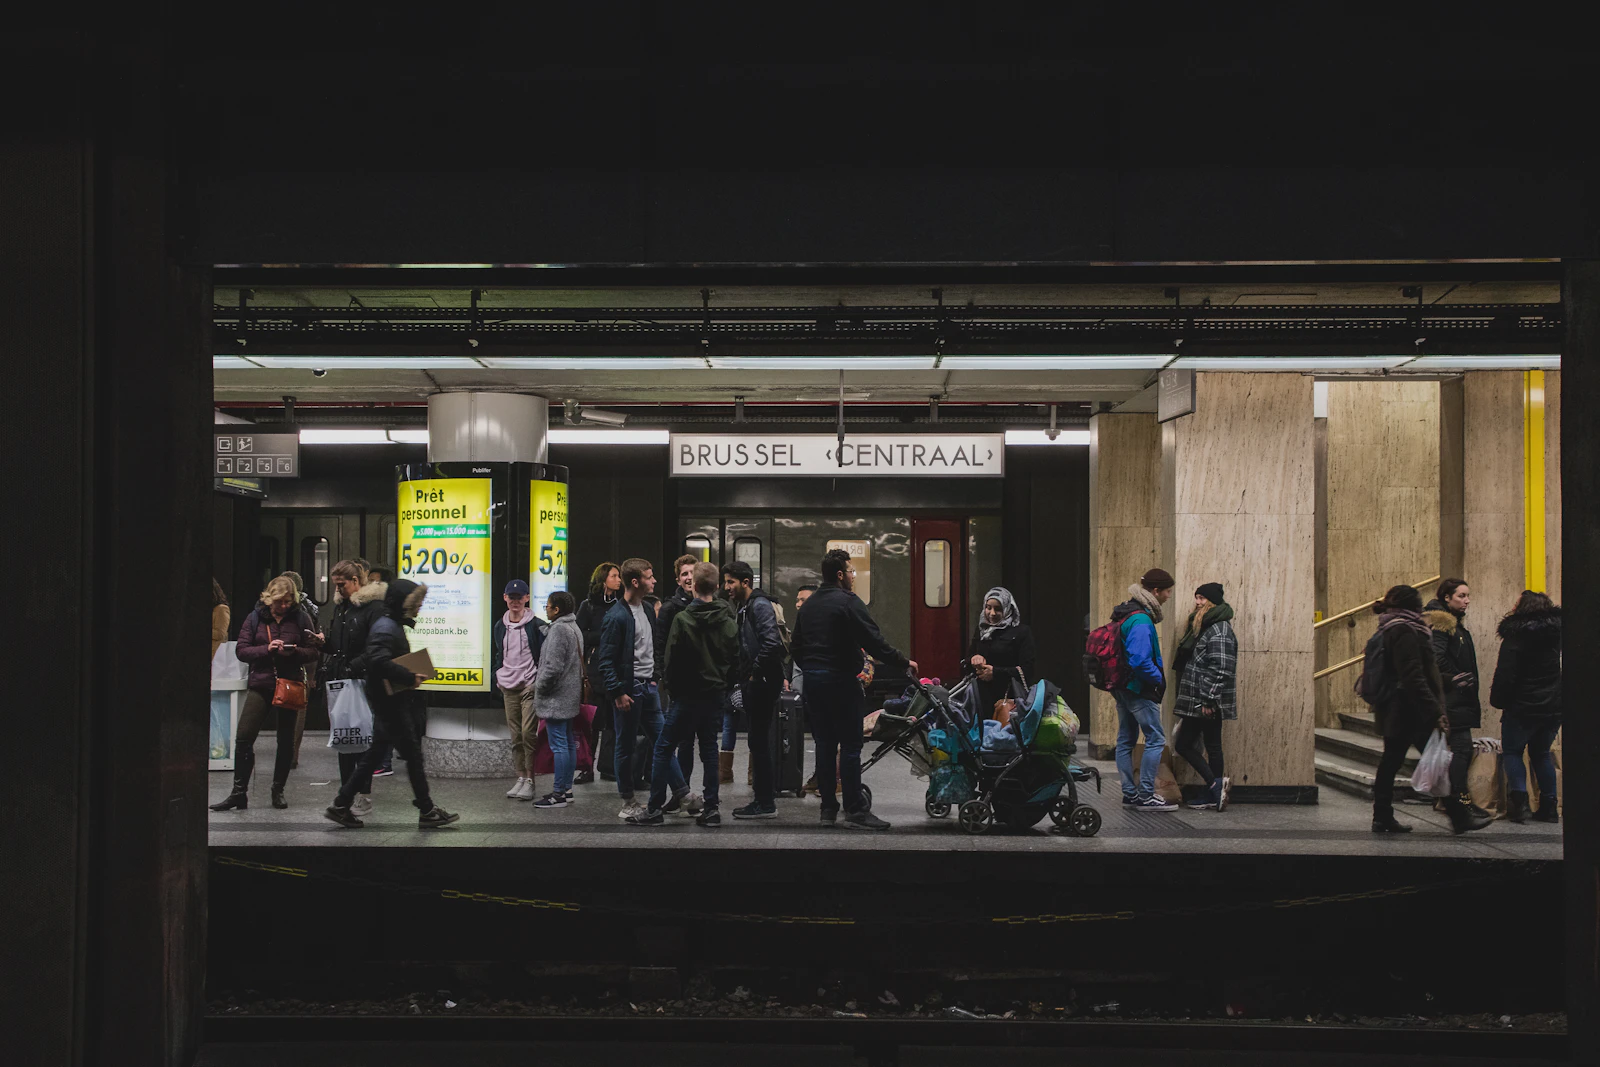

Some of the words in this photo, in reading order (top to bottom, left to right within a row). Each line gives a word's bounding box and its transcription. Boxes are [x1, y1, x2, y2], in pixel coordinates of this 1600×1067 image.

[680, 443, 802, 466] BRUSSEL
[835, 443, 984, 467] CENTRAAL
[416, 488, 444, 503] Prêt
[402, 505, 466, 524] personnel
[446, 527, 466, 535] 15.000
[402, 543, 474, 578] 5,20%
[433, 617, 446, 625] 026
[431, 669, 479, 682] bank
[333, 727, 361, 736] ETTER
